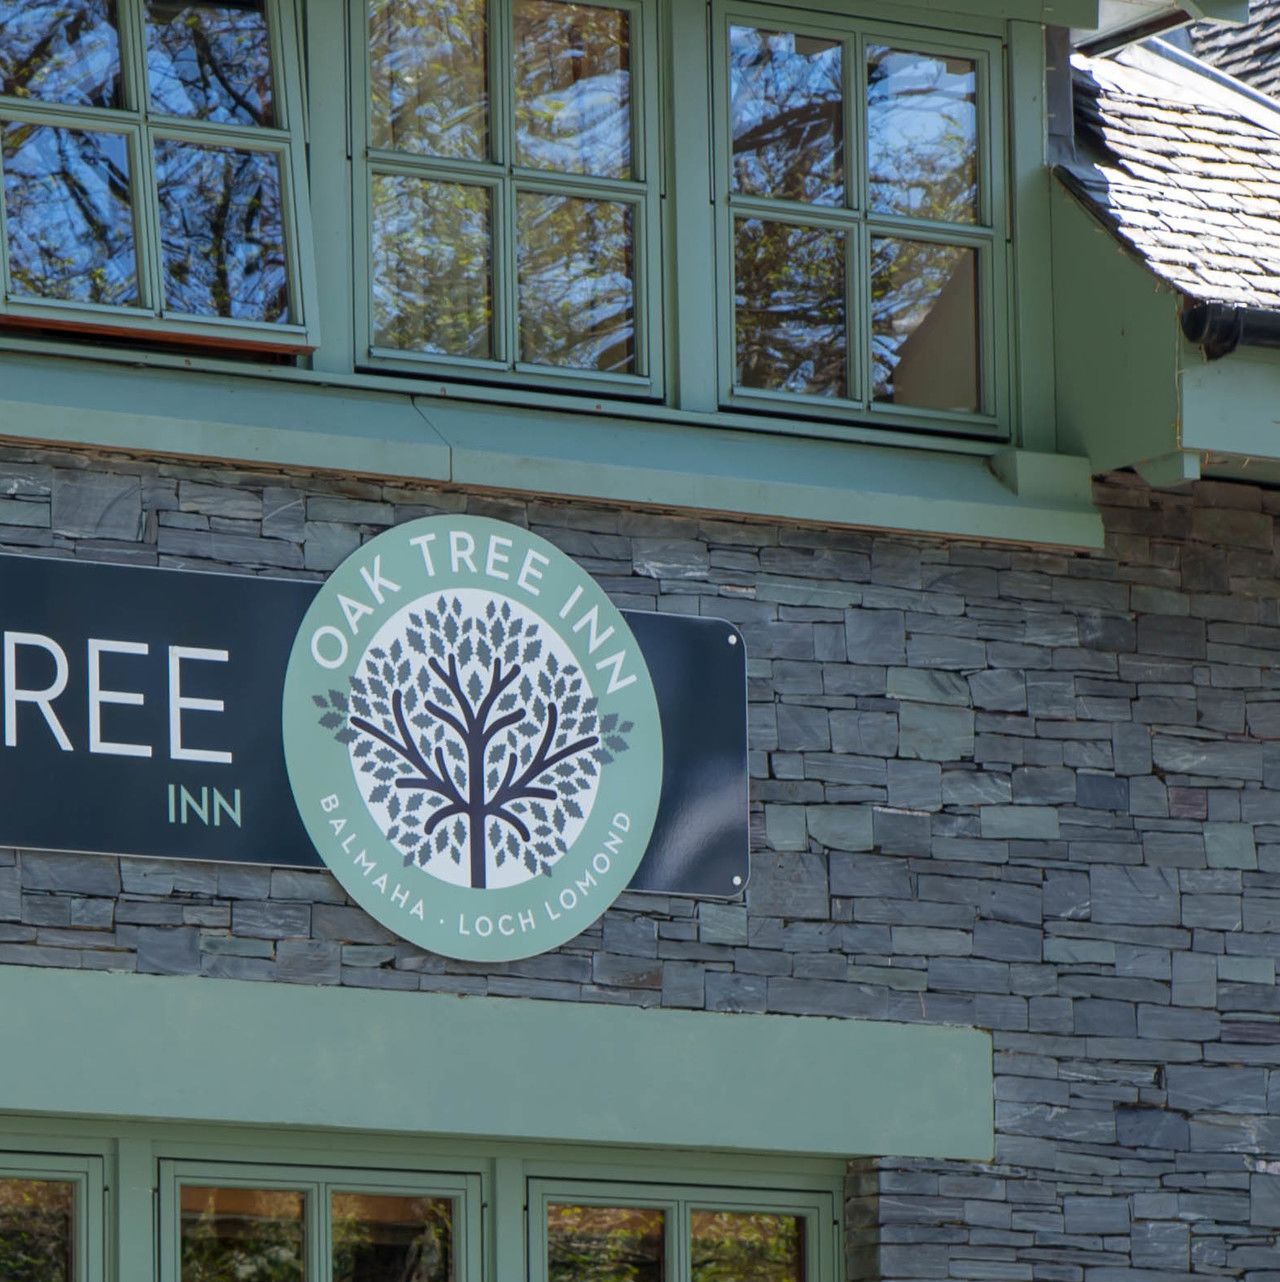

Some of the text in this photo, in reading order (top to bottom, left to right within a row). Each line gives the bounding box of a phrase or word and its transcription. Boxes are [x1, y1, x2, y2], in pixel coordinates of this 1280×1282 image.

[310, 530, 639, 696] OAK TREE INN
[166, 783, 243, 829] INN
[319, 792, 632, 937] BALMAHA LOCH LOMOND
